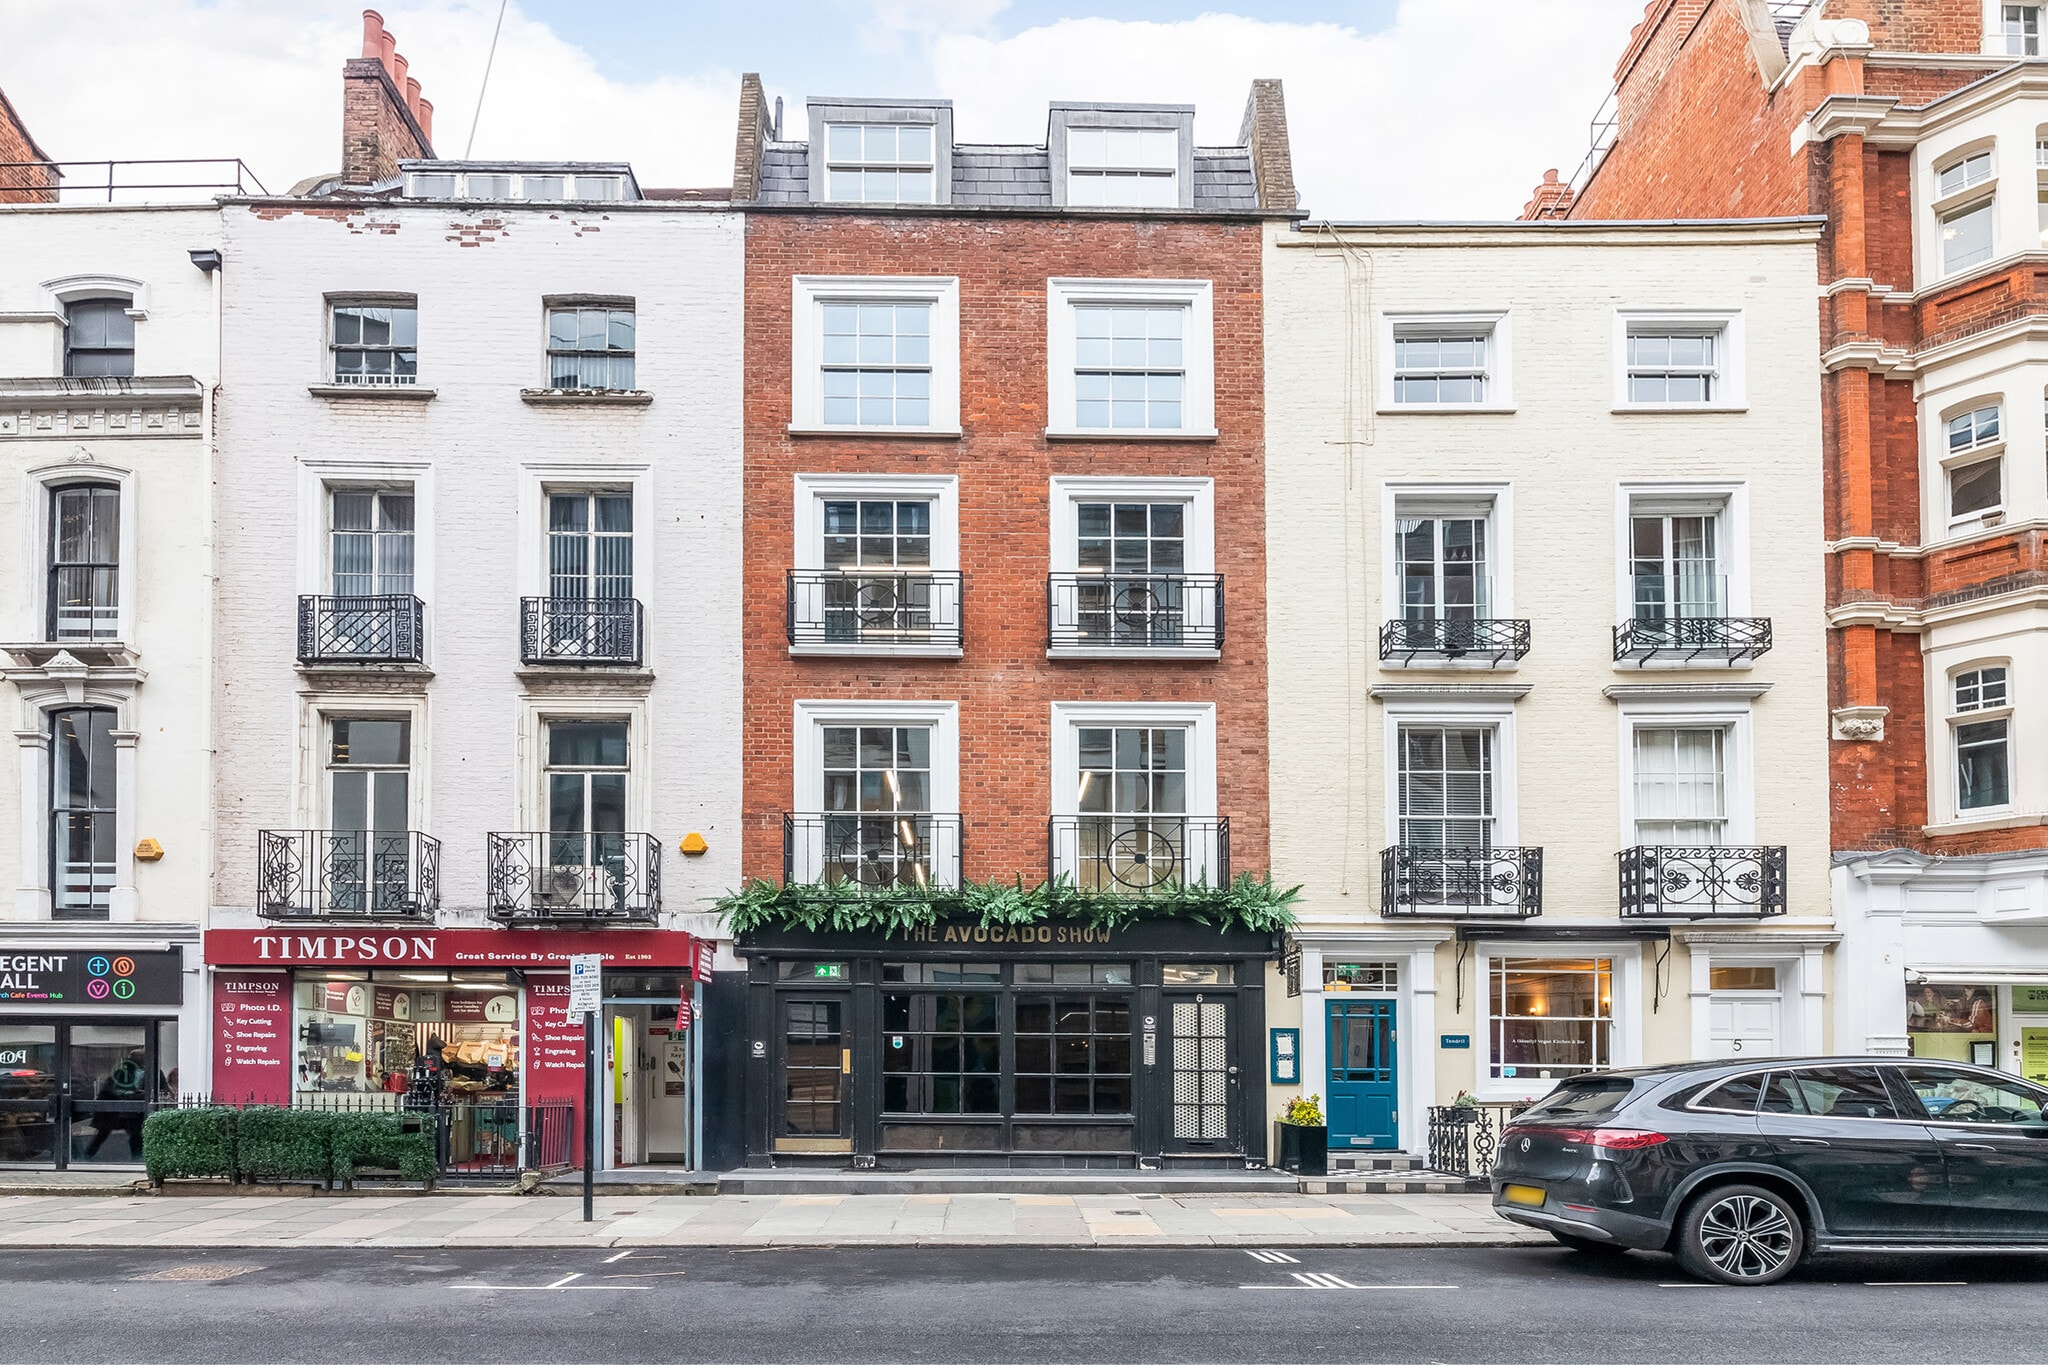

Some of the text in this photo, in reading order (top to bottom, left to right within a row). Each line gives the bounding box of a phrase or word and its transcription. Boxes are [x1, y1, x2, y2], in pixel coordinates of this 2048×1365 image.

[902, 926, 1111, 943] THE AVOCADO SHOW
[253, 936, 437, 960] TIMPSON
[531, 953, 543, 962] By
[0, 973, 39, 988] ALL
[225, 982, 279, 990] TIMPSON
[533, 985, 571, 993] TIMPS
[1196, 994, 1203, 1003] 6
[240, 1003, 283, 1012] Photo I.D.
[549, 1006, 569, 1015] Phot
[236, 1018, 272, 1026] Key Cutting
[253, 1031, 276, 1039] Repairs
[366, 1020, 374, 1061] SECURITY
[1733, 1039, 1742, 1051] 5
[236, 1044, 268, 1053] Engraving
[544, 1047, 576, 1056] Engraving
[257, 1058, 280, 1066] Repairs
